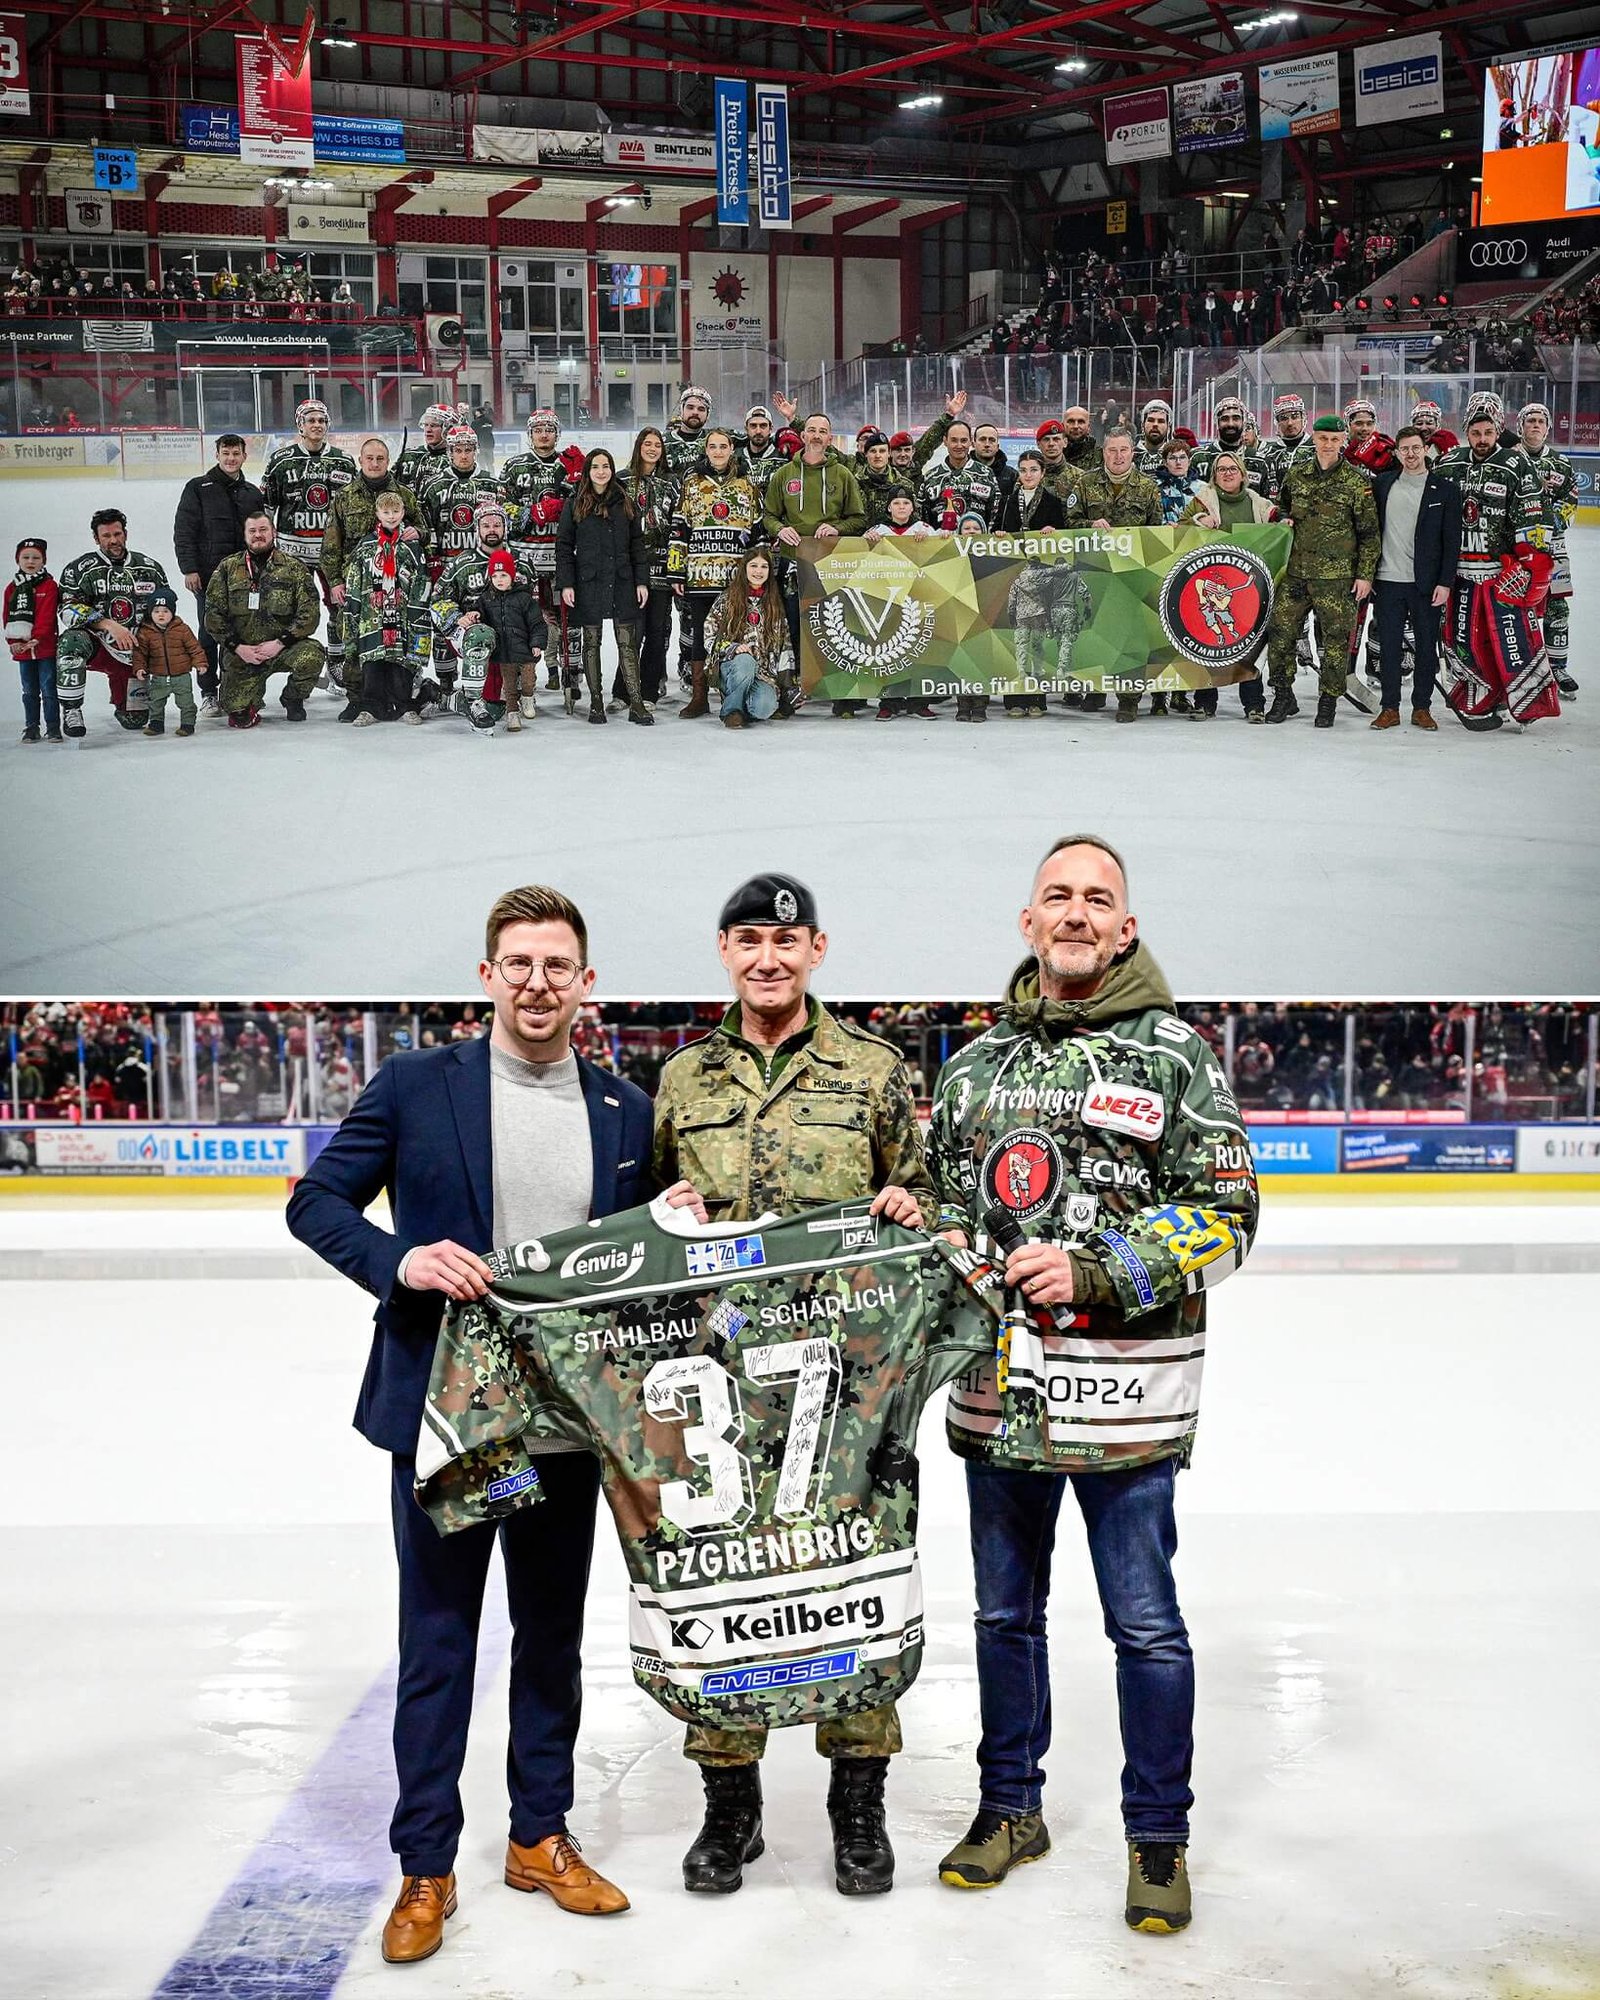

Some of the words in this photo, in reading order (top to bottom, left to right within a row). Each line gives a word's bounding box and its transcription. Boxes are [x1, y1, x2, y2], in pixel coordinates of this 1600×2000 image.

[1361, 66, 1436, 93] besico
[726, 99, 742, 146] Freie
[1131, 122, 1166, 138] PORZIG
[208, 131, 229, 140] Hess
[97, 152, 131, 163] Block
[655, 143, 712, 156] BANTLEON
[760, 95, 787, 218] besico
[108, 164, 123, 185] B
[726, 148, 743, 206] Presse
[319, 216, 366, 229] Benediktiner
[1546, 237, 1571, 247] Audi
[1545, 250, 1589, 259] Zentrum
[696, 322, 725, 331] Check
[738, 316, 761, 325] Point
[36, 331, 74, 341] Partner
[14, 444, 75, 461] Freiberger
[287, 469, 299, 483] 11
[402, 461, 414, 474] 27
[516, 473, 532, 488] 42
[927, 485, 940, 500] 37
[689, 530, 734, 543] STAHLBAU
[955, 531, 1133, 557] Veteranentag
[688, 543, 739, 554] SCHÄDLICH
[830, 559, 858, 569] Bund
[860, 559, 913, 569] Deutscher
[1185, 555, 1253, 575] EISPIRATEN
[468, 573, 486, 591] 88
[907, 570, 927, 580] e.V.
[840, 586, 903, 641] V
[1455, 587, 1470, 644] freenet
[809, 603, 823, 638] TREU
[816, 637, 861, 678] GEDIENT
[871, 656, 914, 678] TREUE
[911, 602, 936, 660] VERDIENT
[1182, 631, 1256, 658] CRIMMITSCHAU
[1501, 612, 1525, 667] freenet
[1552, 634, 1567, 647] 89
[62, 672, 79, 686] 79
[469, 664, 485, 678] 88
[921, 678, 984, 696] Danke
[990, 676, 1019, 694] für
[1024, 677, 1095, 693] Deinen
[1101, 673, 1181, 693] Einsatz!
[813, 1078, 853, 1090] MARKUS
[985, 1081, 1085, 1116] Freiberger
[1004, 1134, 1049, 1151] EISPIRATEN
[993, 1197, 1045, 1217] CITSCHAU
[845, 1229, 875, 1246] DFA
[1104, 1229, 1154, 1305] AMBOSELI
[573, 1317, 697, 1353] STAHLBAU
[760, 1284, 896, 1328] SCHÄDLICH
[642, 1336, 843, 1538] 37
[656, 1517, 875, 1585] PZGRENBRIG
[722, 1595, 885, 1644] Keilberg
[707, 1657, 851, 1691] AMBOSELI
